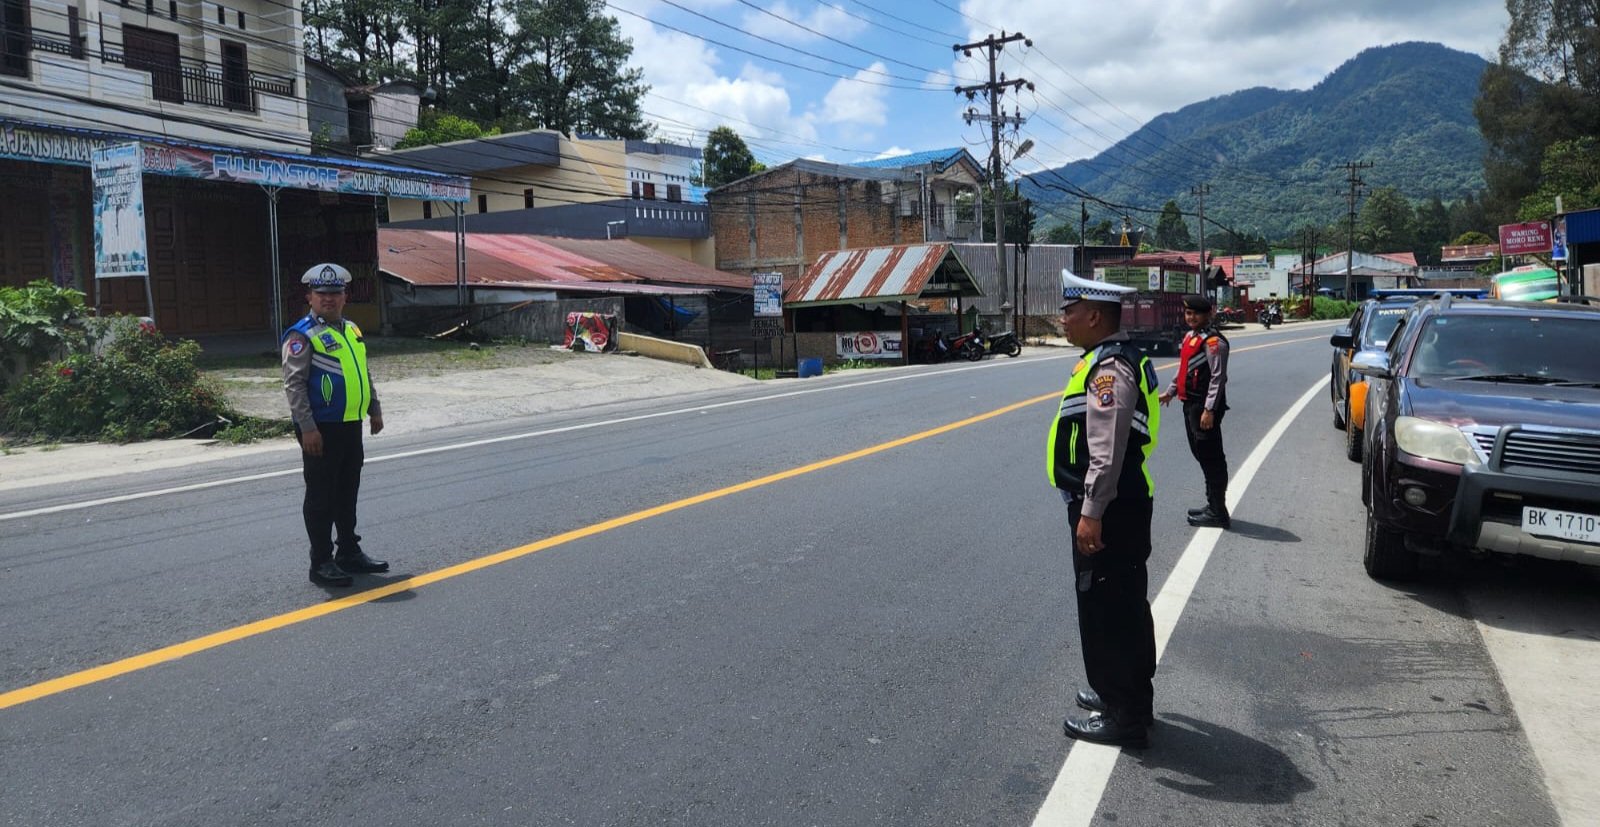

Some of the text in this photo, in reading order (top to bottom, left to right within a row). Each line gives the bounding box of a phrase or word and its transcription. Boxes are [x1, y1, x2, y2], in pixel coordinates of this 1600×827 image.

[10, 129, 51, 157] JENIS
[1528, 510, 1595, 532] BK 1710
